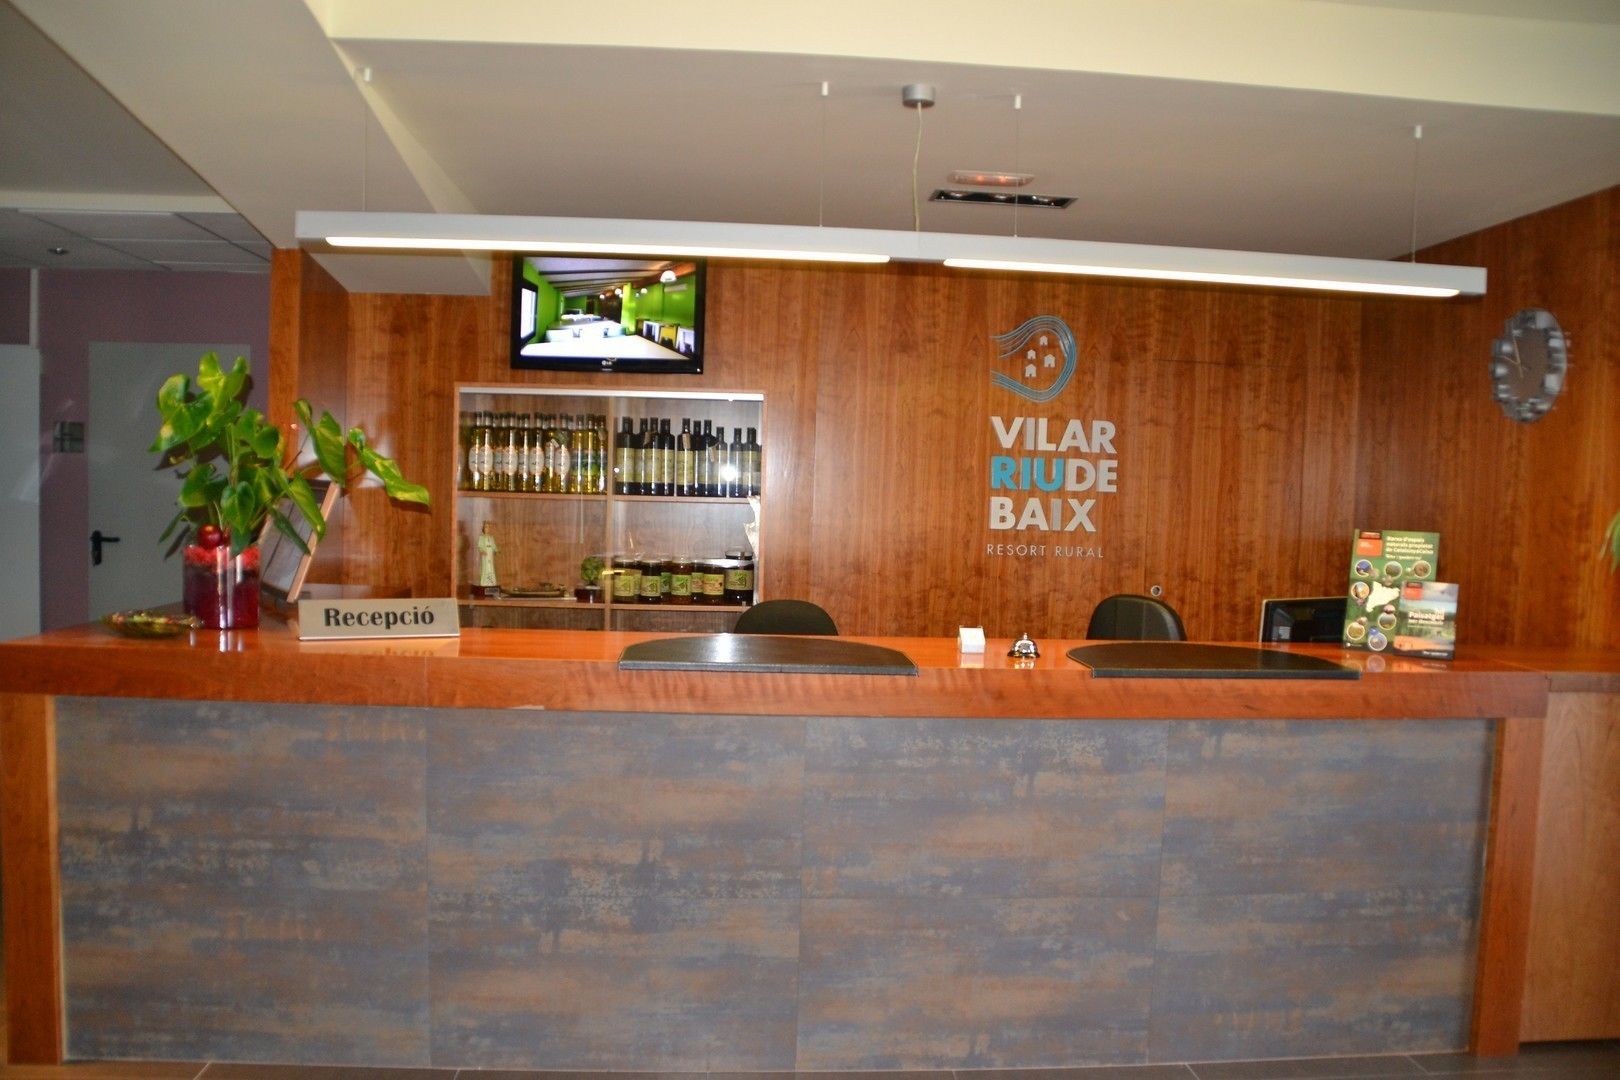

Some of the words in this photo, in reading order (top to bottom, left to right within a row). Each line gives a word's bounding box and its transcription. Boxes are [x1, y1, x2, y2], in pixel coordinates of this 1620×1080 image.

[990, 416, 1117, 454] VILAR
[990, 455, 1118, 493] RIUDE
[989, 496, 1097, 532] BAIX
[986, 544, 1047, 556] RESORT
[1055, 546, 1104, 558] RURAL
[323, 606, 435, 630] Recepció
